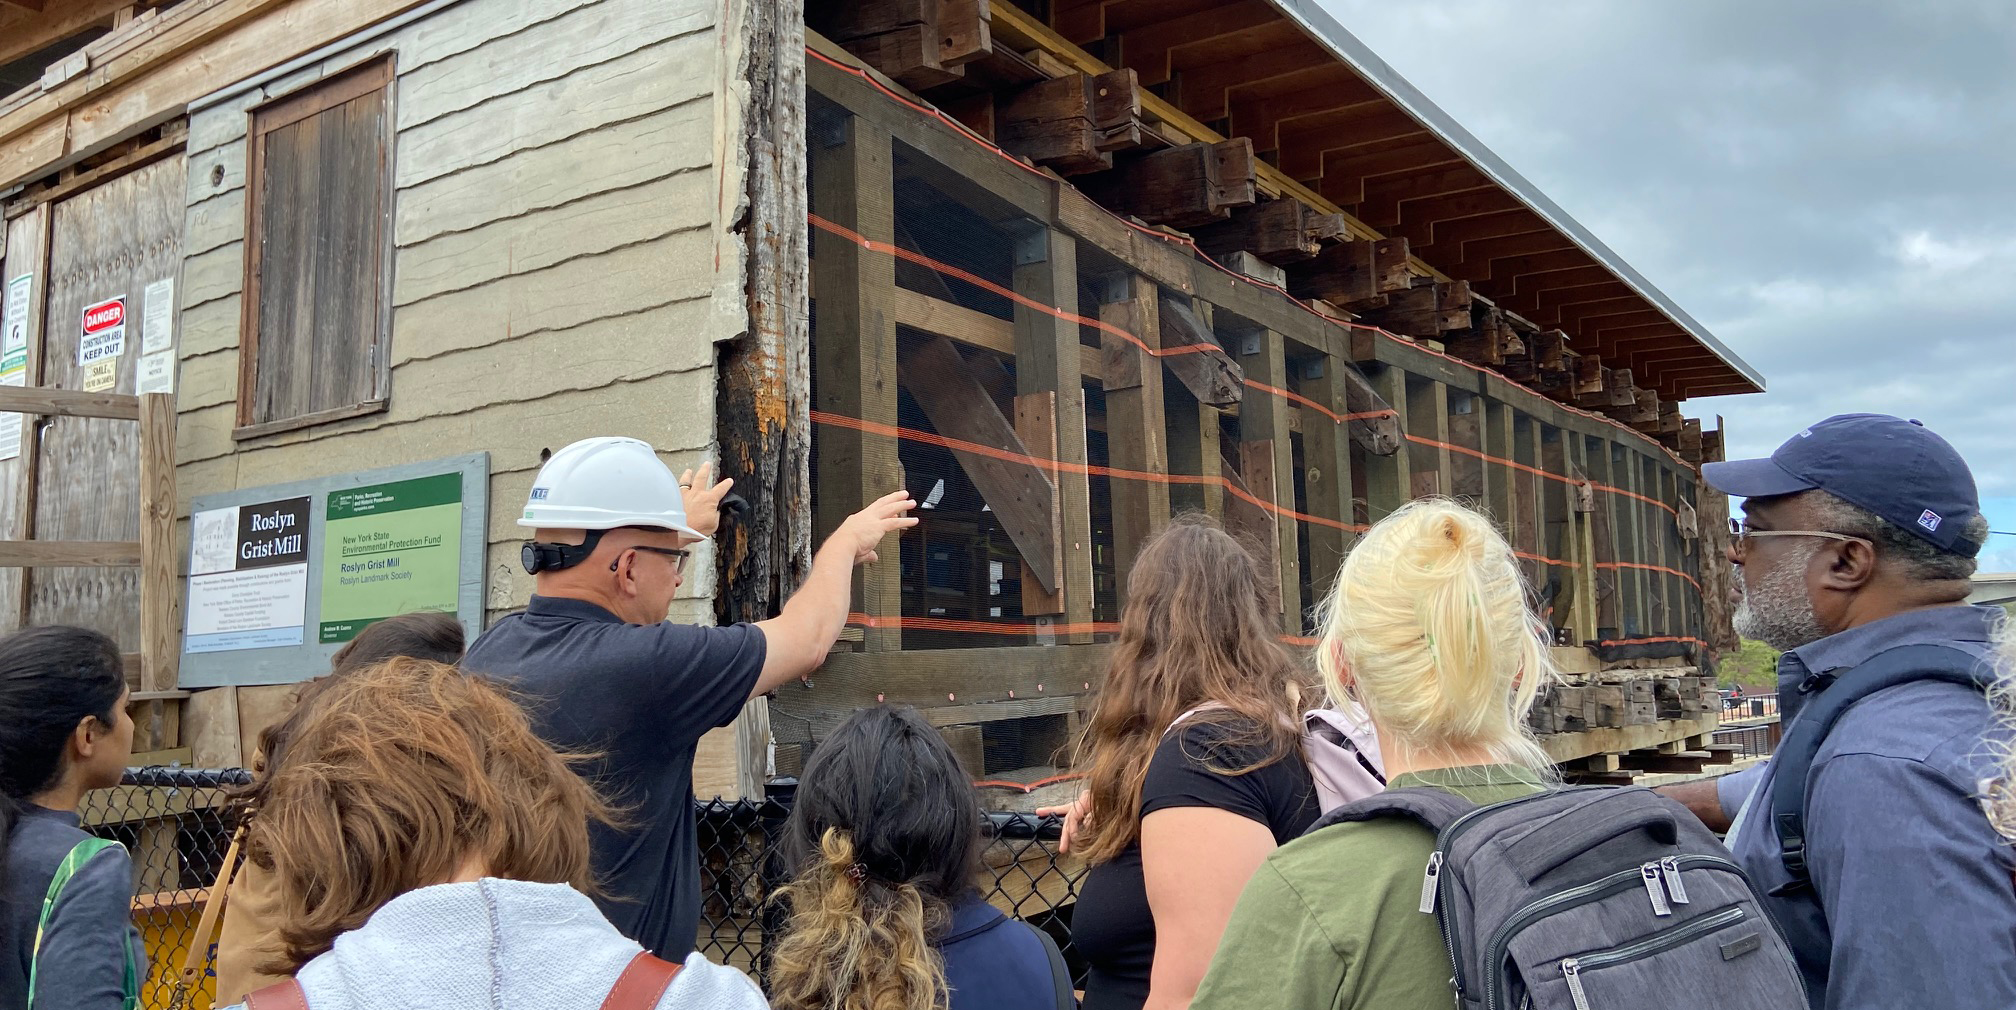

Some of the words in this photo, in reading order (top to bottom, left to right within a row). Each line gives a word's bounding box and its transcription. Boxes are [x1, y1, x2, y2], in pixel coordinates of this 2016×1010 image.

[86, 306, 121, 328] DANGER
[83, 334, 110, 350] CONSTRUCTION
[111, 331, 122, 342] AREA
[84, 346, 102, 361] KEEP
[105, 343, 120, 355] OUT
[93, 365, 107, 377] SMILE
[251, 510, 295, 533] Roslyn
[242, 540, 273, 559] Grist
[274, 534, 301, 555] Mill
[342, 542, 387, 554] Environmental
[389, 538, 422, 549] Protection
[424, 534, 441, 544] Fund
[343, 536, 356, 544] New
[358, 534, 372, 542] York
[341, 563, 365, 573] Roslyn
[368, 560, 385, 570] Grist
[387, 558, 400, 568] Mill
[340, 576, 359, 586] Roslyn
[361, 573, 389, 583] Landmark
[391, 571, 412, 580] Society
